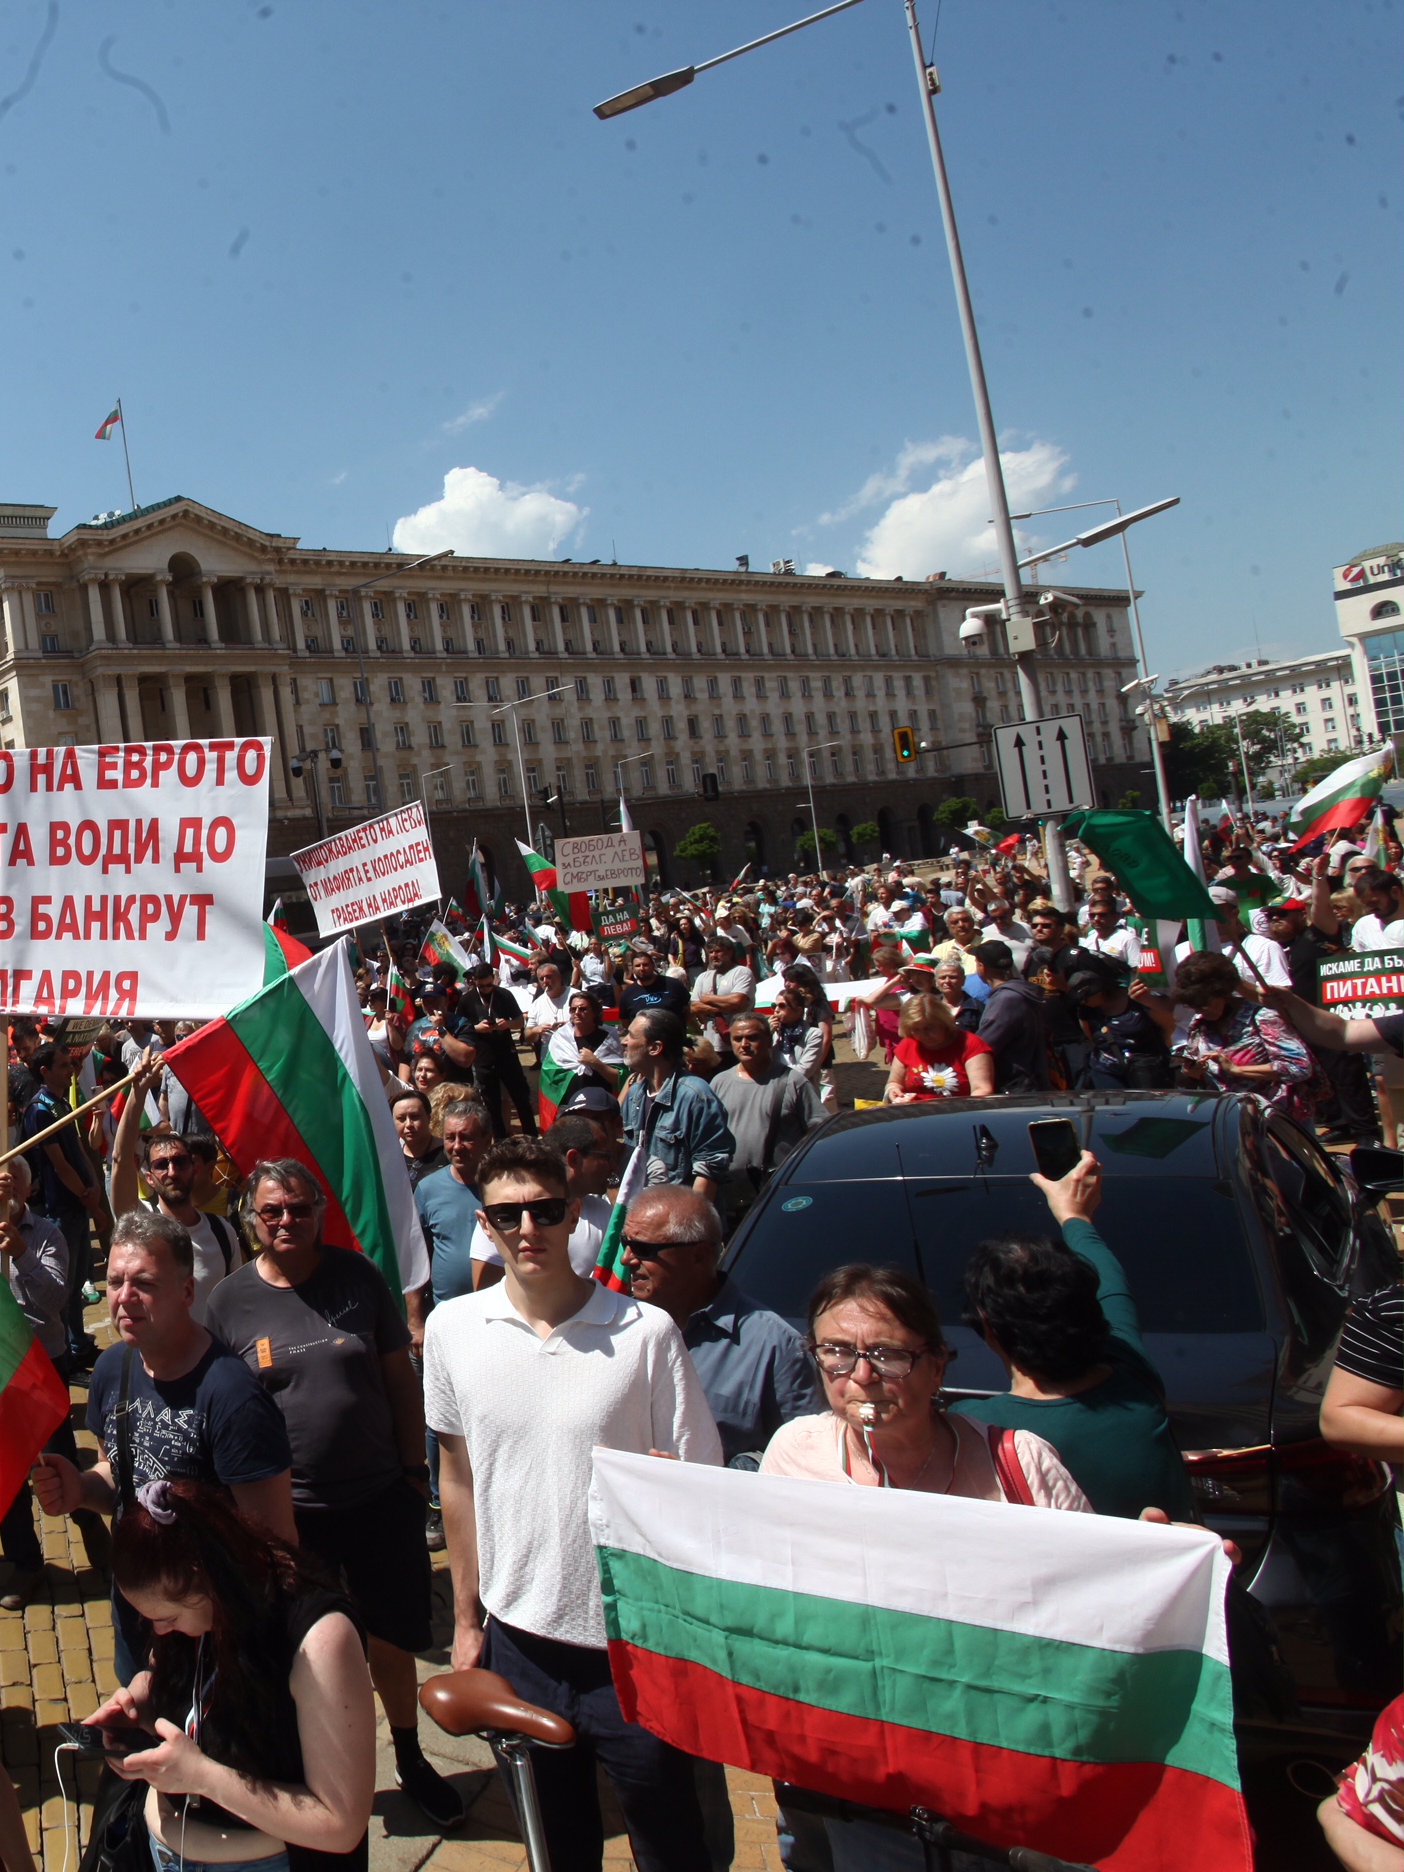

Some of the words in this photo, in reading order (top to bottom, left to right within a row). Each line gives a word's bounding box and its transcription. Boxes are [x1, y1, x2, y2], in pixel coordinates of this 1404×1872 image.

[30, 746, 83, 792] НА
[97, 739, 266, 790] ЕВРОТО
[50, 818, 160, 875] ВОДИ
[174, 816, 236, 873] ДО
[293, 824, 378, 874] УНИЩОЖАВАНЕТО
[378, 817, 395, 841] НА
[561, 835, 627, 858] СВОБОДА
[308, 881, 322, 902] ОТ
[320, 865, 364, 898] МАФИЯТА
[362, 862, 373, 883] Е
[371, 839, 432, 879] КОЛОСАЛЕН
[31, 894, 214, 942] БАНКРУТ
[331, 899, 367, 928] ГРАБЕЖ
[365, 894, 381, 917] НА
[379, 879, 423, 911] НАРОДА!
[601, 915, 615, 925] ДА
[616, 911, 630, 921] НА
[603, 922, 631, 935] ЛЕВА!
[1320, 959, 1361, 976] ИСКАМЕ
[1363, 957, 1382, 971] ДА
[1384, 955, 1404, 968] БЪ
